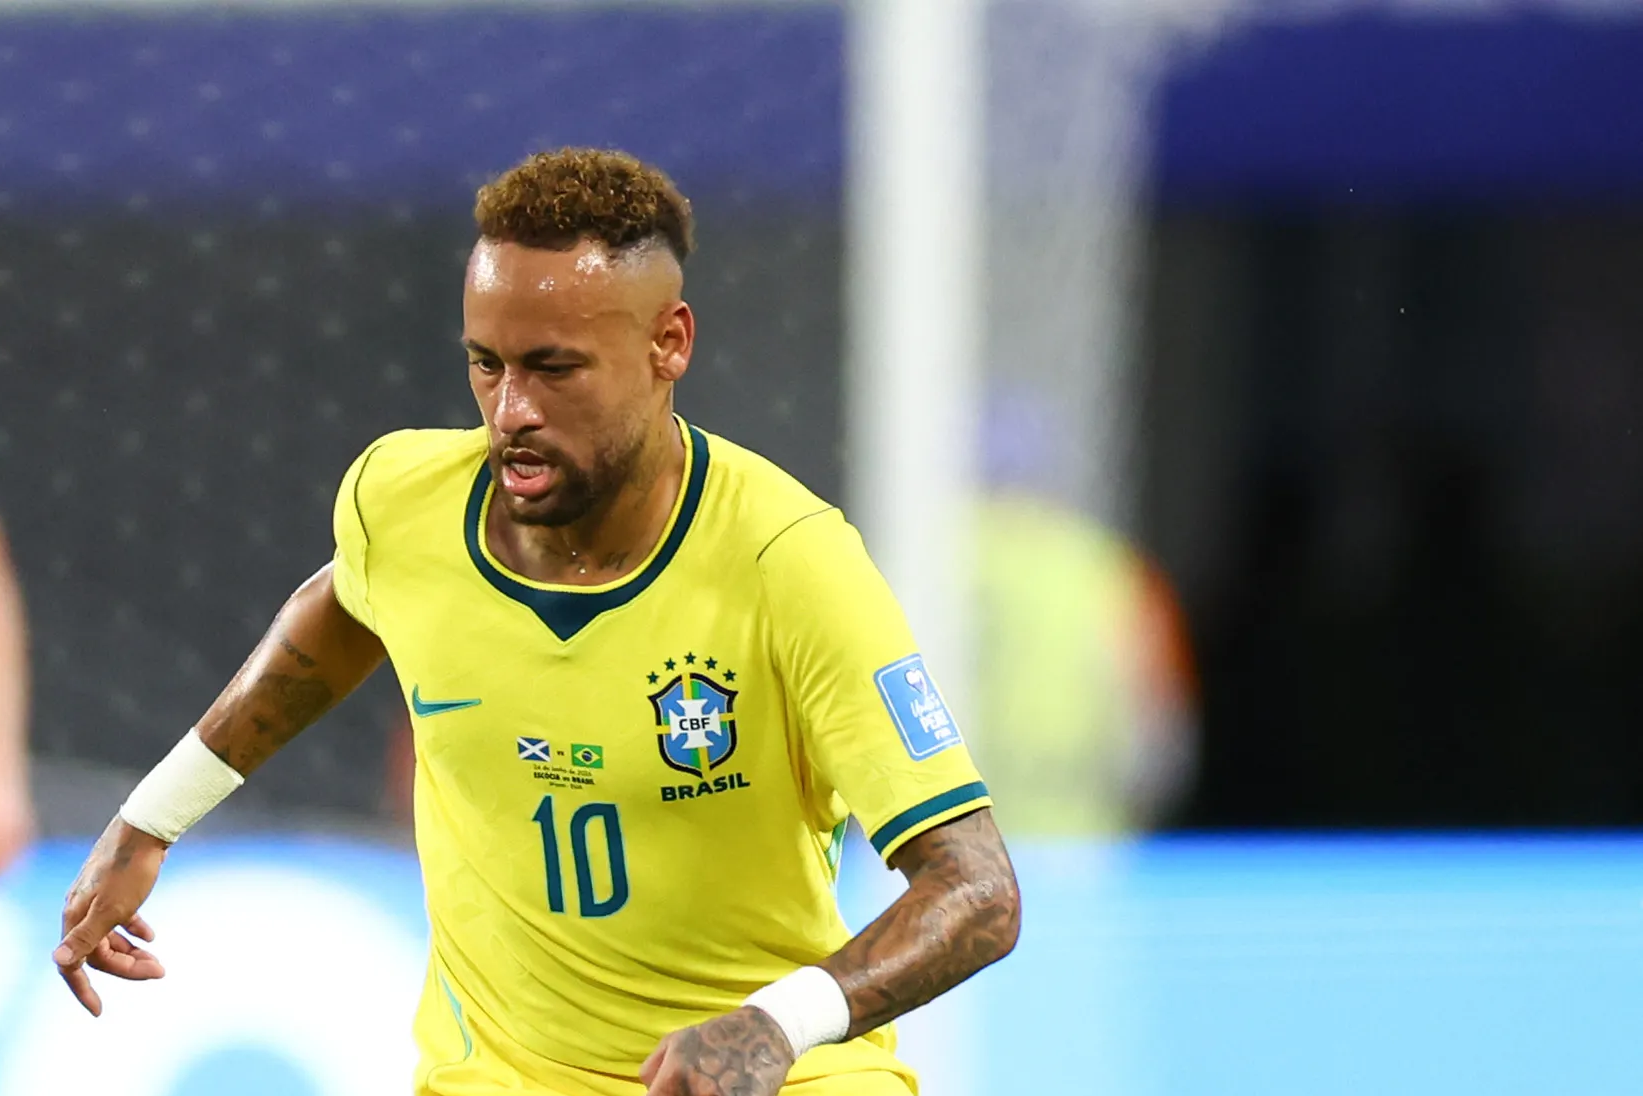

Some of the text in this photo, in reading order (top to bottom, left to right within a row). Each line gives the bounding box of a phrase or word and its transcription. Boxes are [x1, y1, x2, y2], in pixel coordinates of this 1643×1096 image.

[679, 717, 710, 731] CBF
[661, 772, 750, 802] BRASIL
[531, 795, 629, 917] 10
